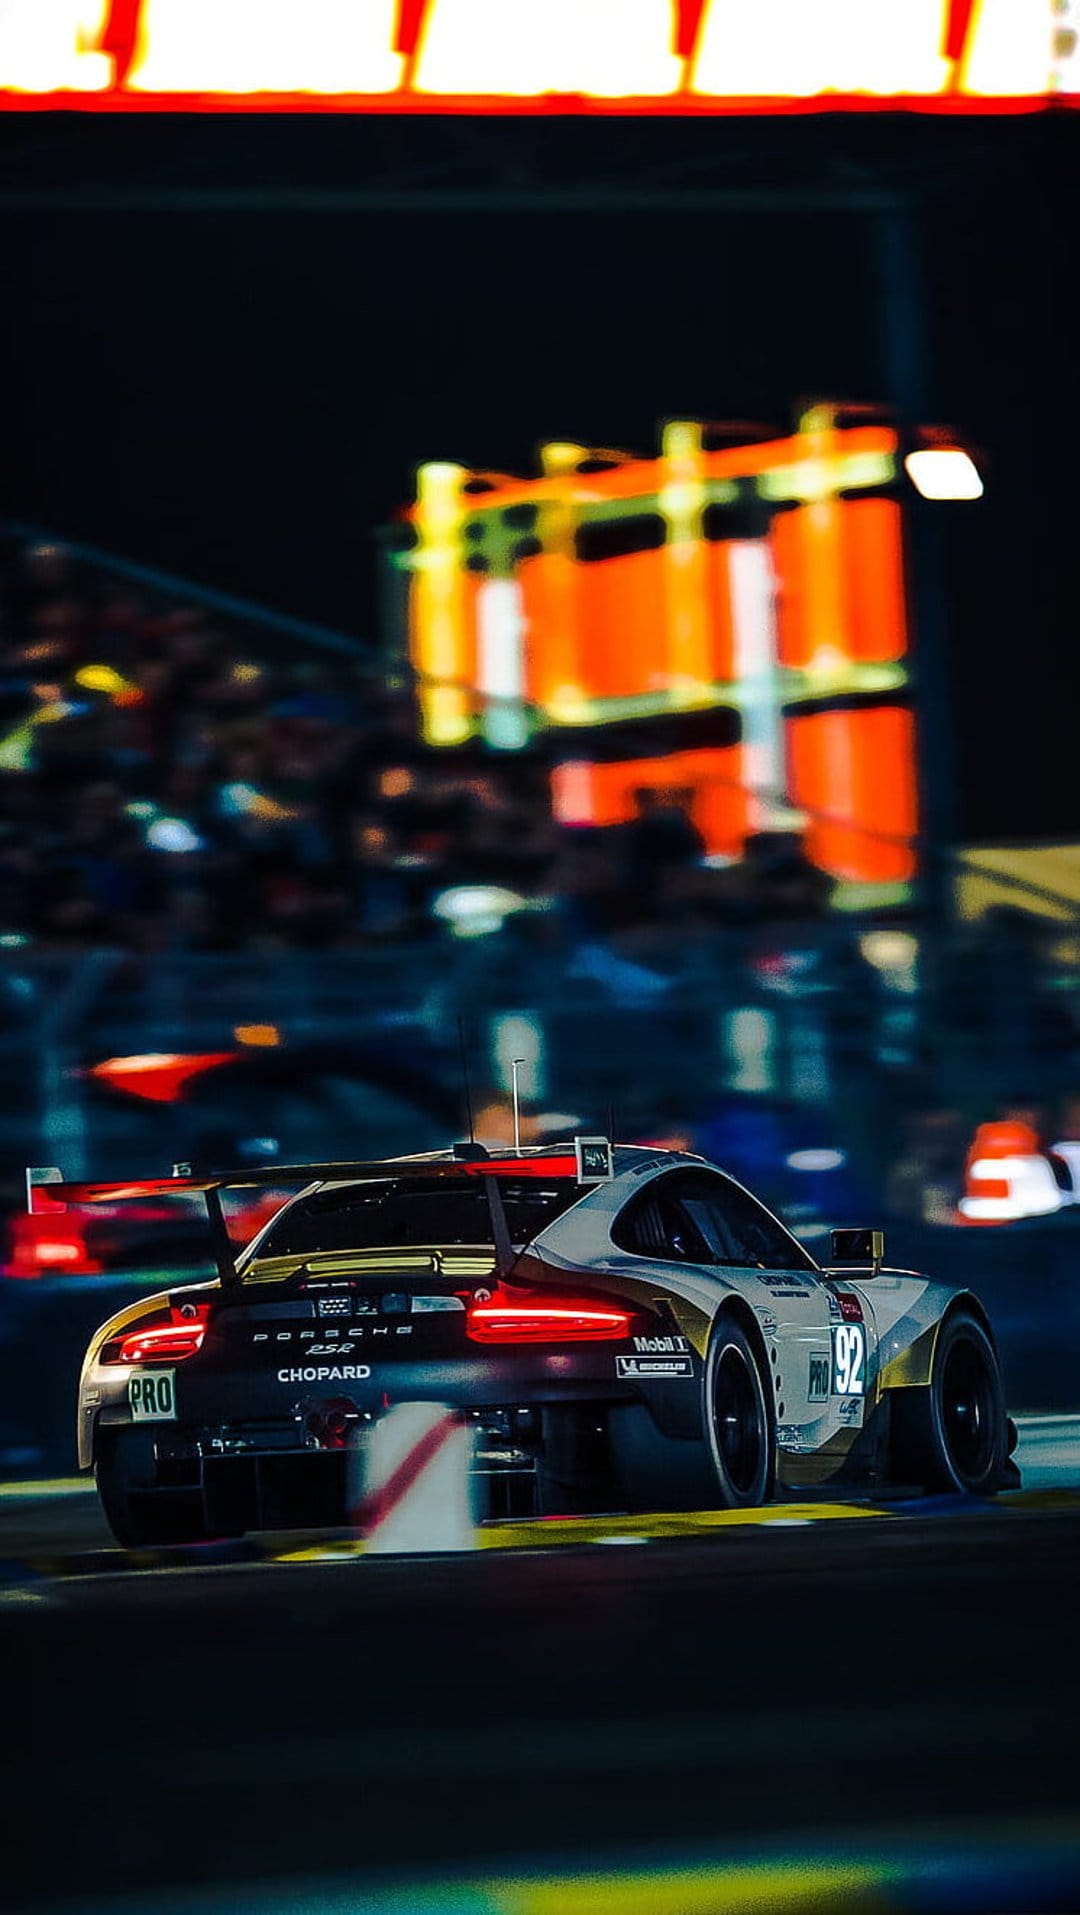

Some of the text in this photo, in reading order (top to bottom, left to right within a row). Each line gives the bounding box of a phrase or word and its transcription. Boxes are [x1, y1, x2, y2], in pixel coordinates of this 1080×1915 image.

[253, 1325, 413, 1341] PORSCHE
[305, 1343, 355, 1356] RSR
[633, 1337, 674, 1352] Mobil
[835, 1325, 863, 1394] 92
[277, 1365, 371, 1382] CHOPARD
[809, 1360, 829, 1395] PRO
[131, 1377, 172, 1414] PRO
